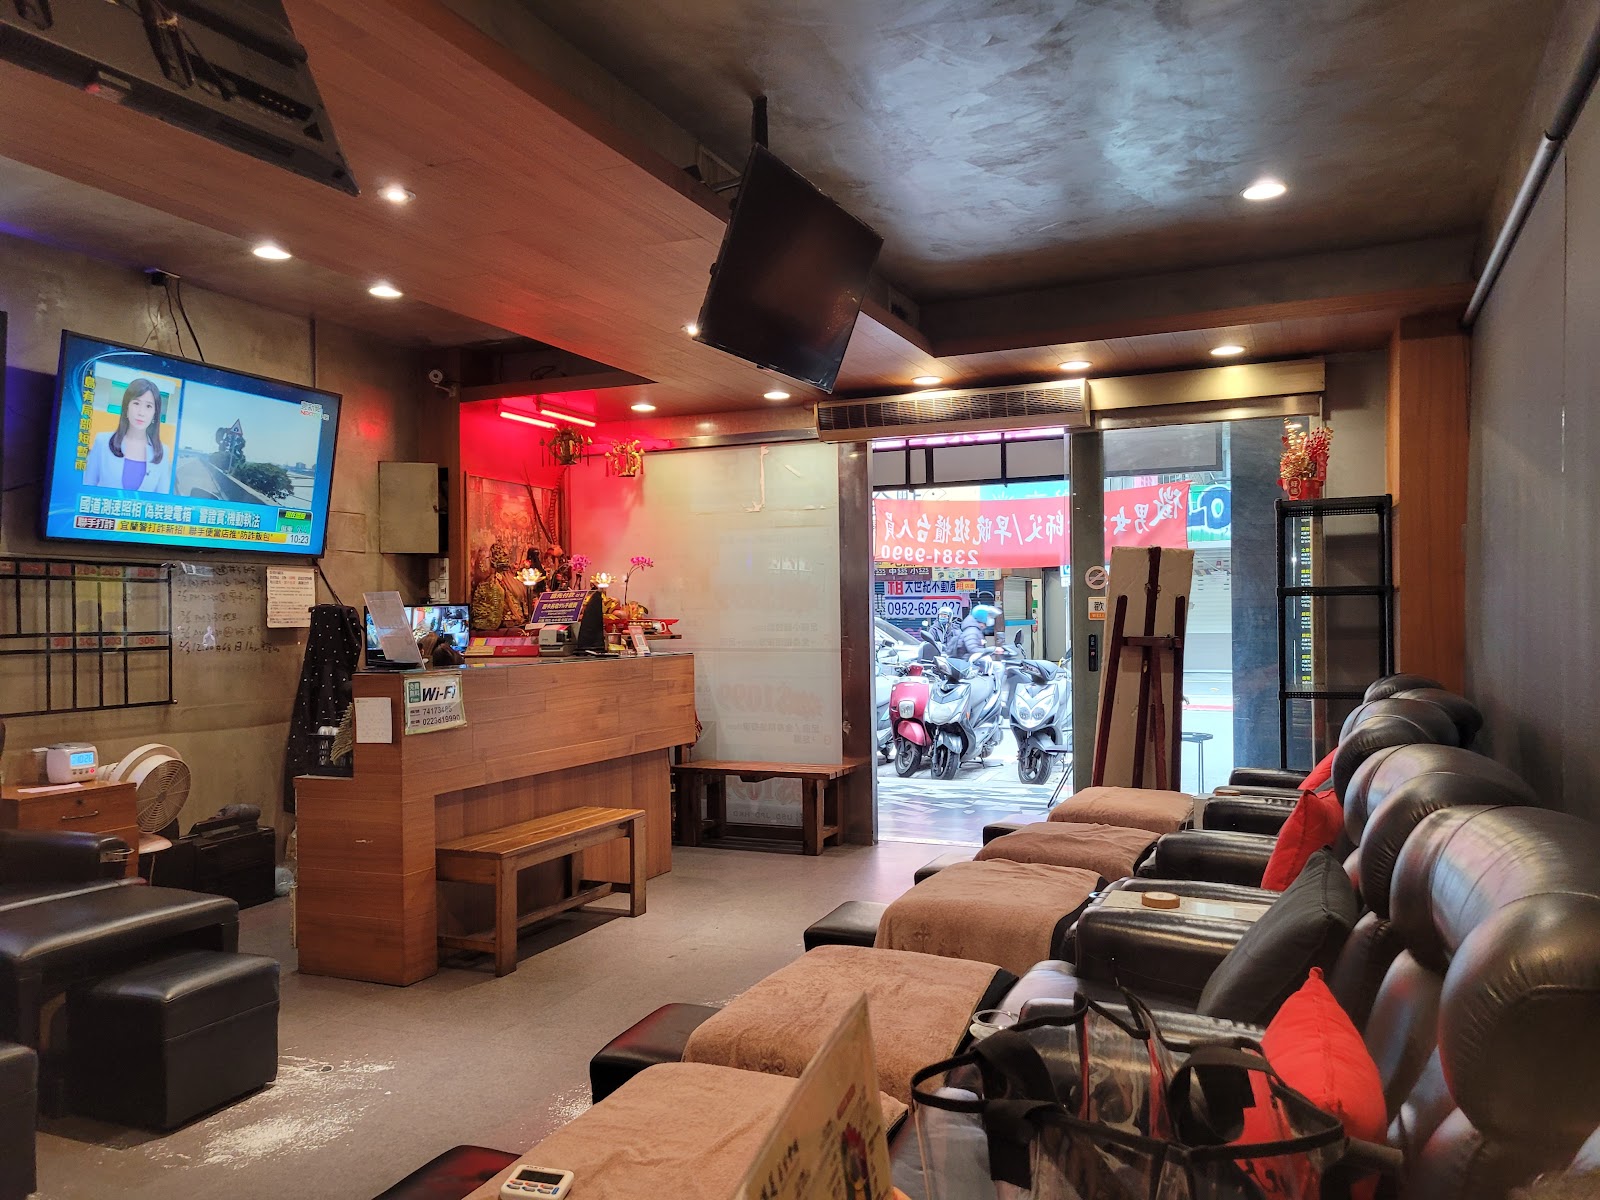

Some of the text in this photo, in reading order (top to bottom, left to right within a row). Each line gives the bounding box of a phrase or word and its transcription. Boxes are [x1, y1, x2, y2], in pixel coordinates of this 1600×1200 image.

[290, 534, 309, 544] 10:23
[888, 582, 903, 594] 租
[1094, 602, 1104, 611] 歡
[422, 685, 456, 702] Wi-Fi
